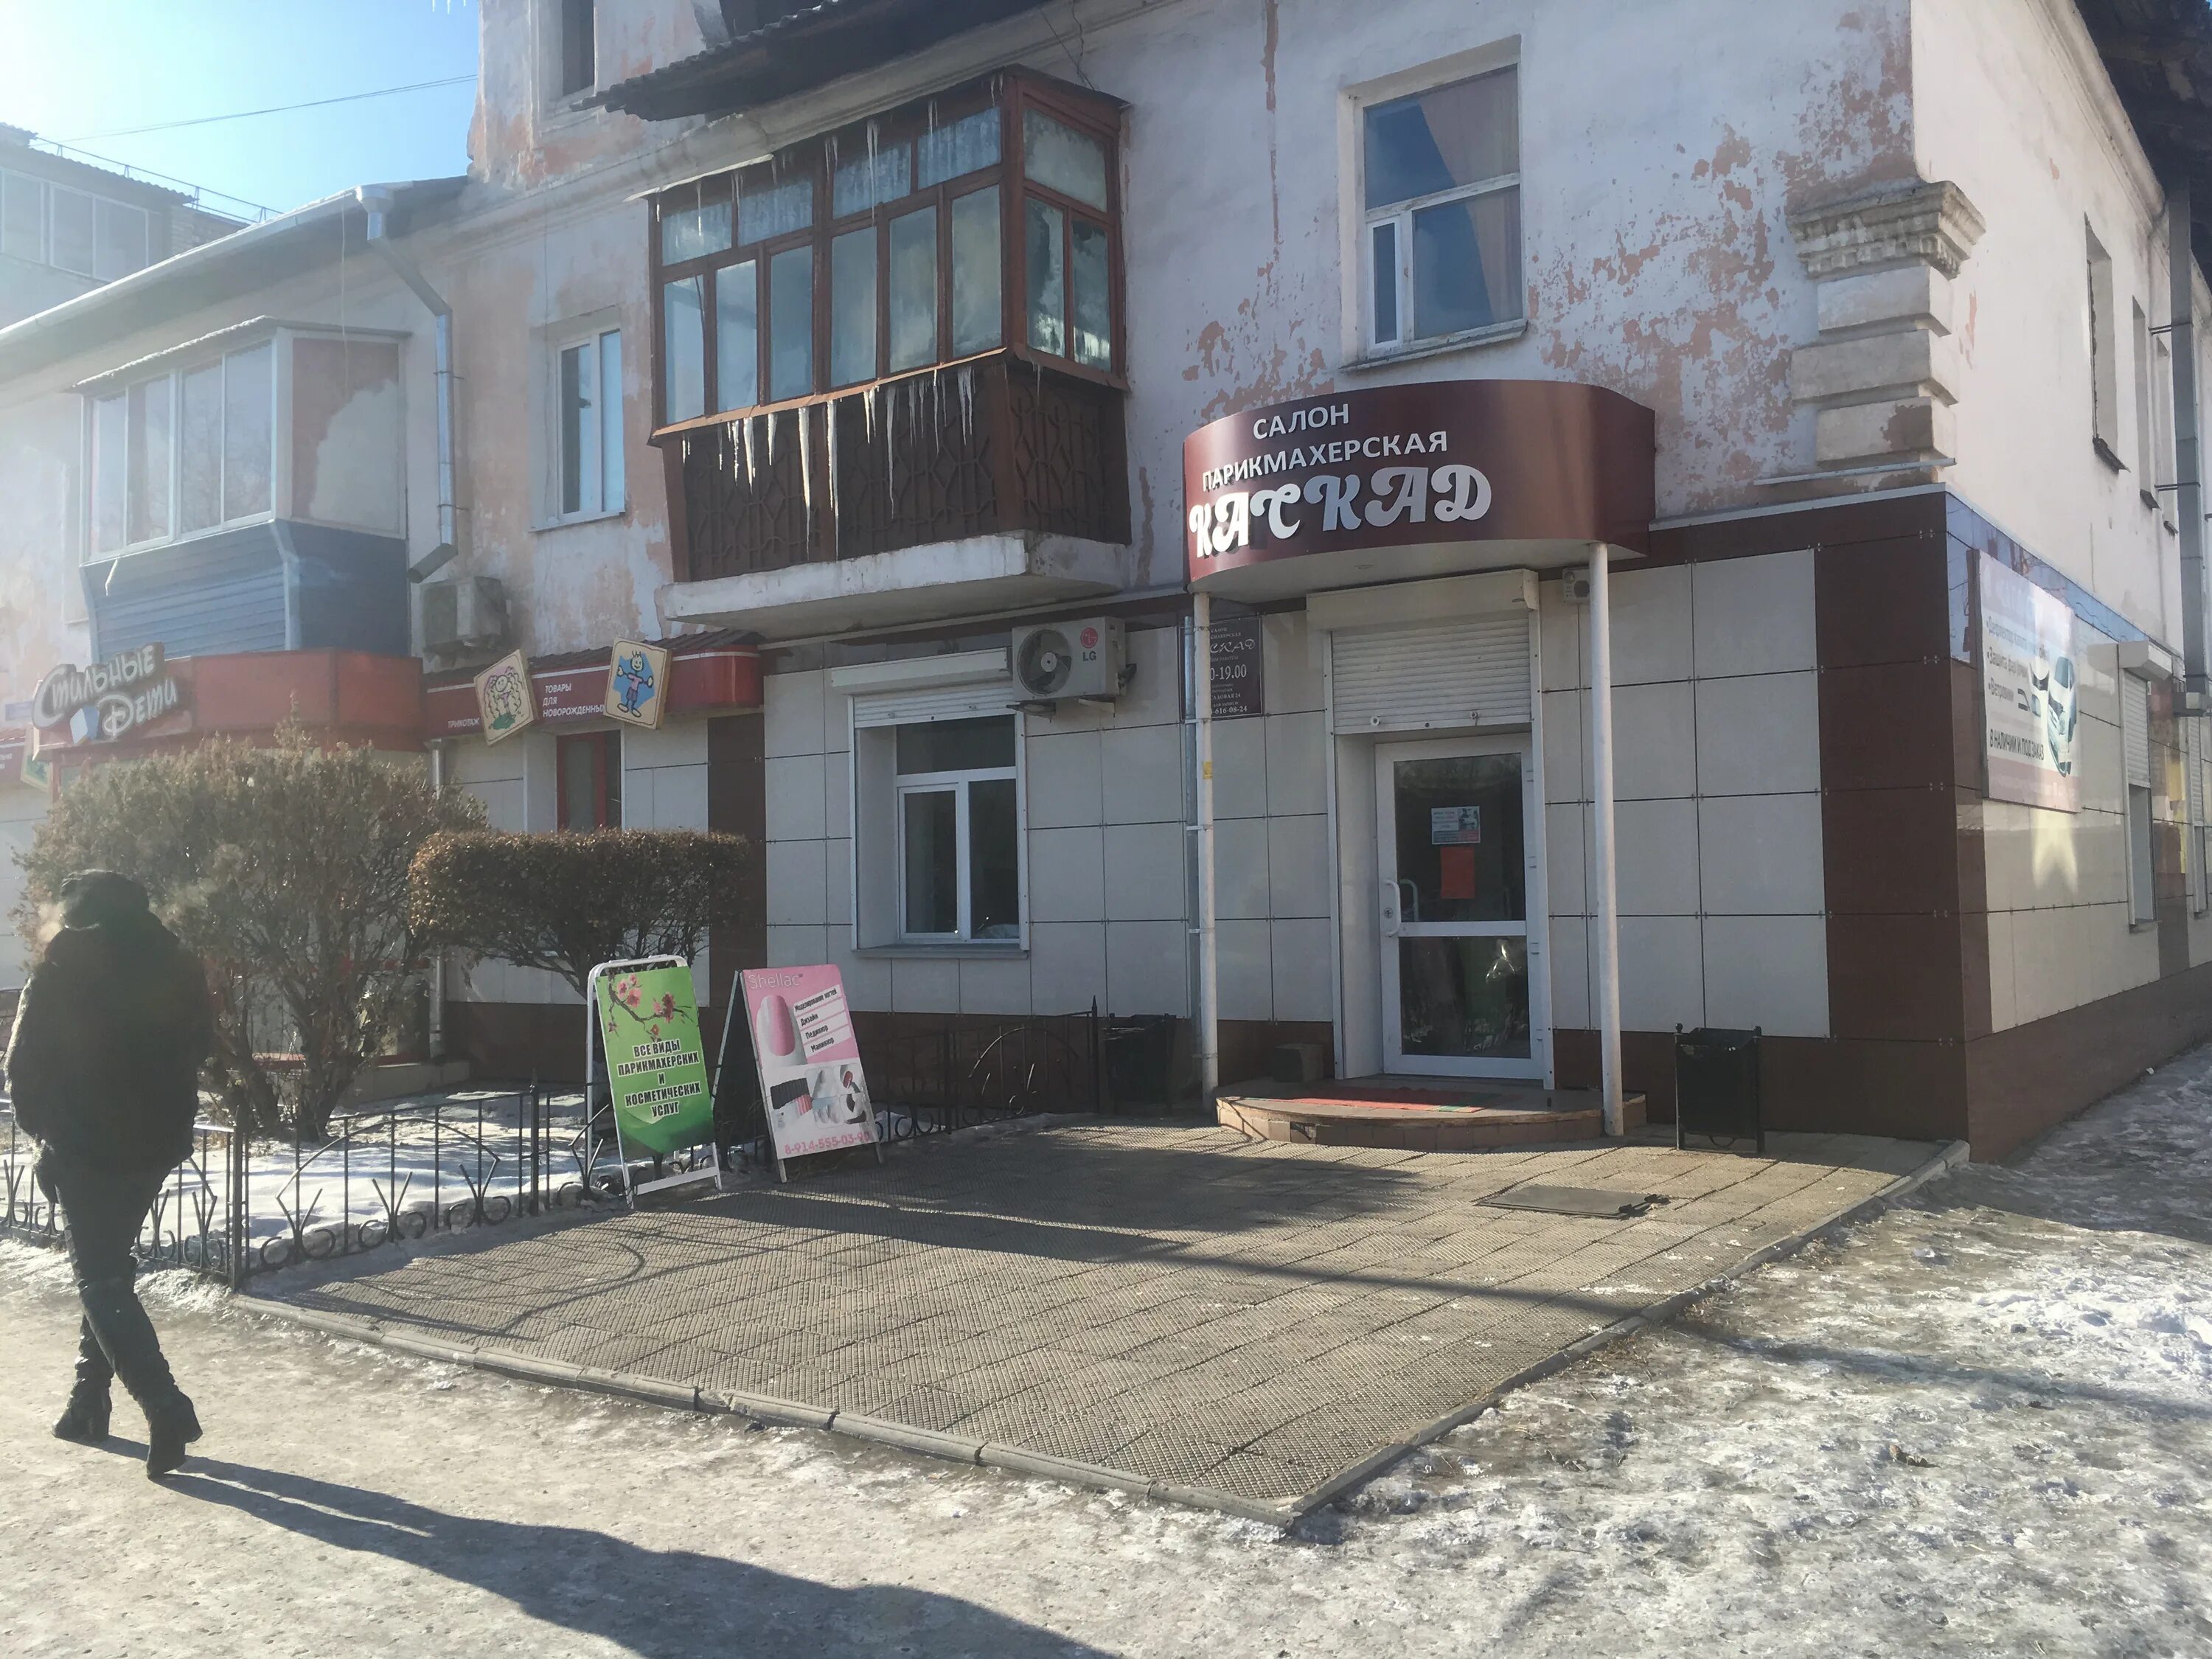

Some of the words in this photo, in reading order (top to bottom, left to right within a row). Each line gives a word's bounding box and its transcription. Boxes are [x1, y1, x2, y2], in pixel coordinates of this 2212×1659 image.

[1253, 403, 1349, 439] САЛОН
[1203, 430, 1447, 492] ПАРИКМАХЕРСКАЯ
[1189, 464, 1492, 558] КАСКАД
[1210, 639, 1255, 653] СКАД
[1082, 650, 1097, 661] LG
[545, 683, 572, 694] ТОВАРЫ
[543, 696, 557, 707] ДЛЯ
[543, 704, 605, 717] НОВОРОЖДЕННЫ
[748, 973, 799, 990] Shellac
[800, 1013, 819, 1027] Дизайн
[805, 1025, 829, 1040] Педикюр
[633, 1043, 652, 1057] ВСЕ
[653, 1039, 681, 1054] ВИДЫ
[810, 1037, 835, 1053] Маникюр
[617, 1051, 700, 1077] ПАРИКМАХЕРСКИХ
[658, 1073, 665, 1085] И
[625, 1082, 701, 1107] КОСМЕТИЧЕСКИХ
[651, 1102, 679, 1118] УСЛУГ
